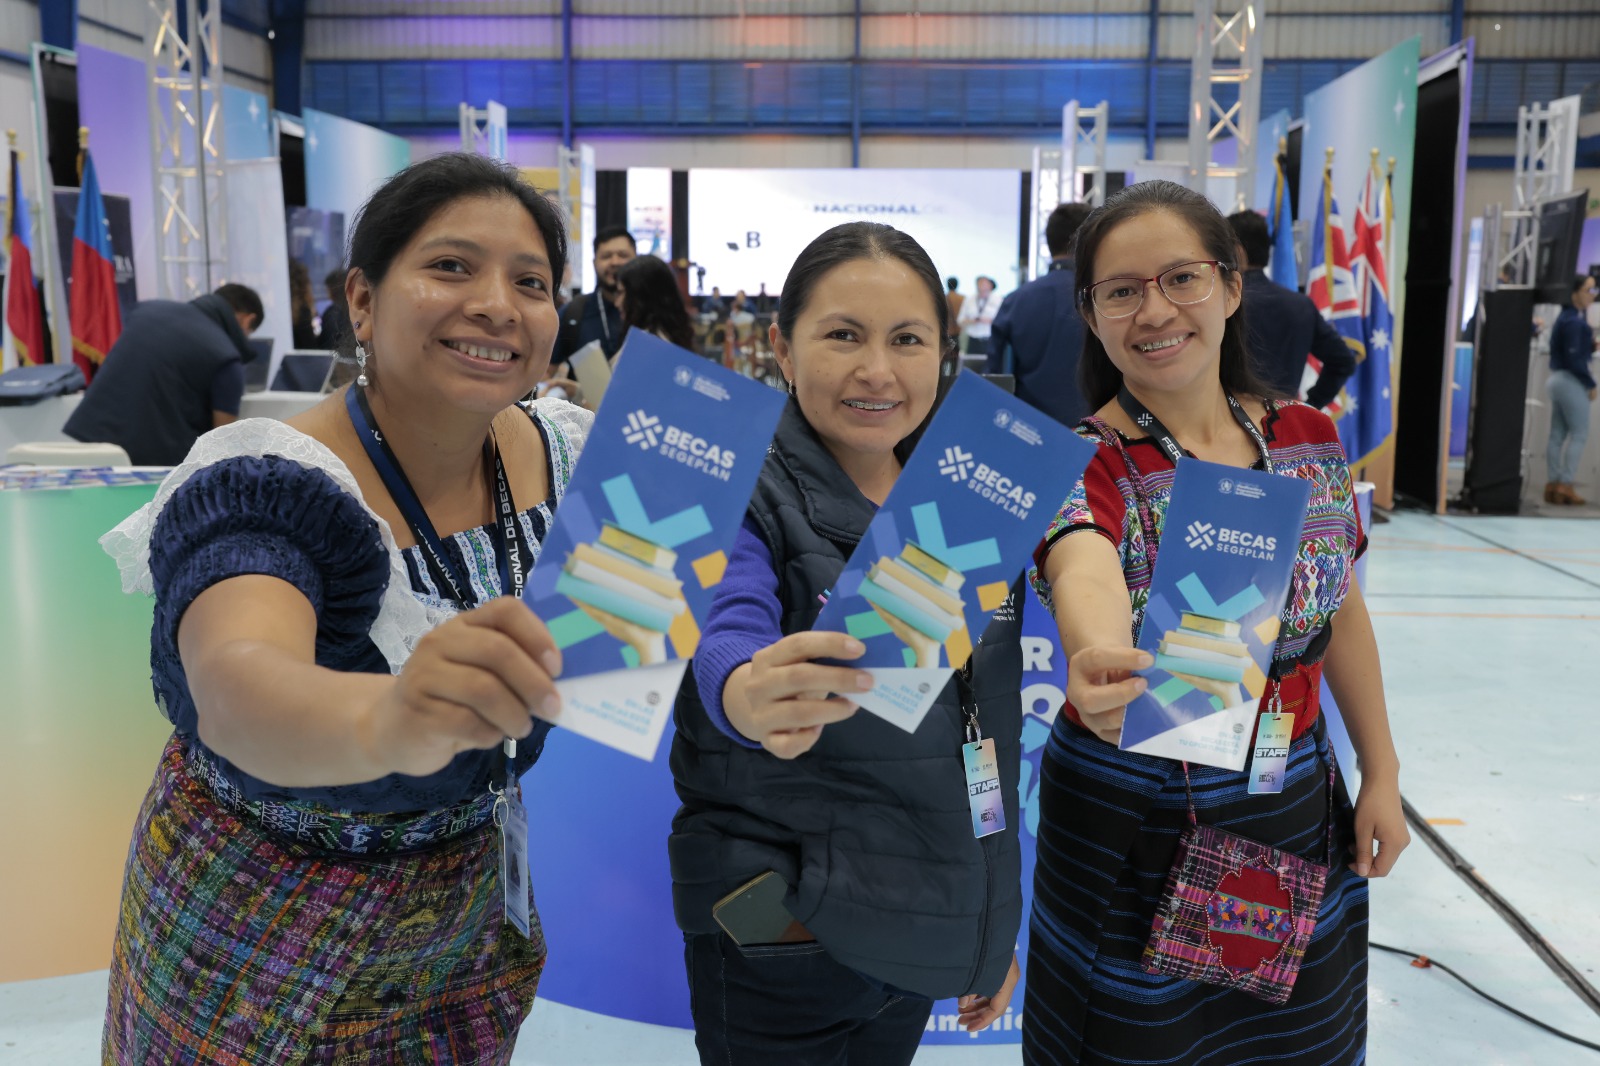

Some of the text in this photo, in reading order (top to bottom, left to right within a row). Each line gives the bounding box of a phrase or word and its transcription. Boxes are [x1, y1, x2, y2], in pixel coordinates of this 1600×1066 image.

[813, 203, 920, 215] NACIONAL
[662, 423, 737, 471] BECAS
[1161, 435, 1183, 460] FER
[658, 442, 731, 483] SEGEPLAN
[973, 462, 1037, 510] BECAS
[966, 478, 1029, 521] SEGEPLAN
[496, 458, 524, 600] CIONAL DE BECAS
[1217, 526, 1278, 552] BECAS
[1216, 543, 1275, 562] SEGEPLAN
[1255, 748, 1288, 757] STAFF
[969, 778, 1000, 796] STAFF
